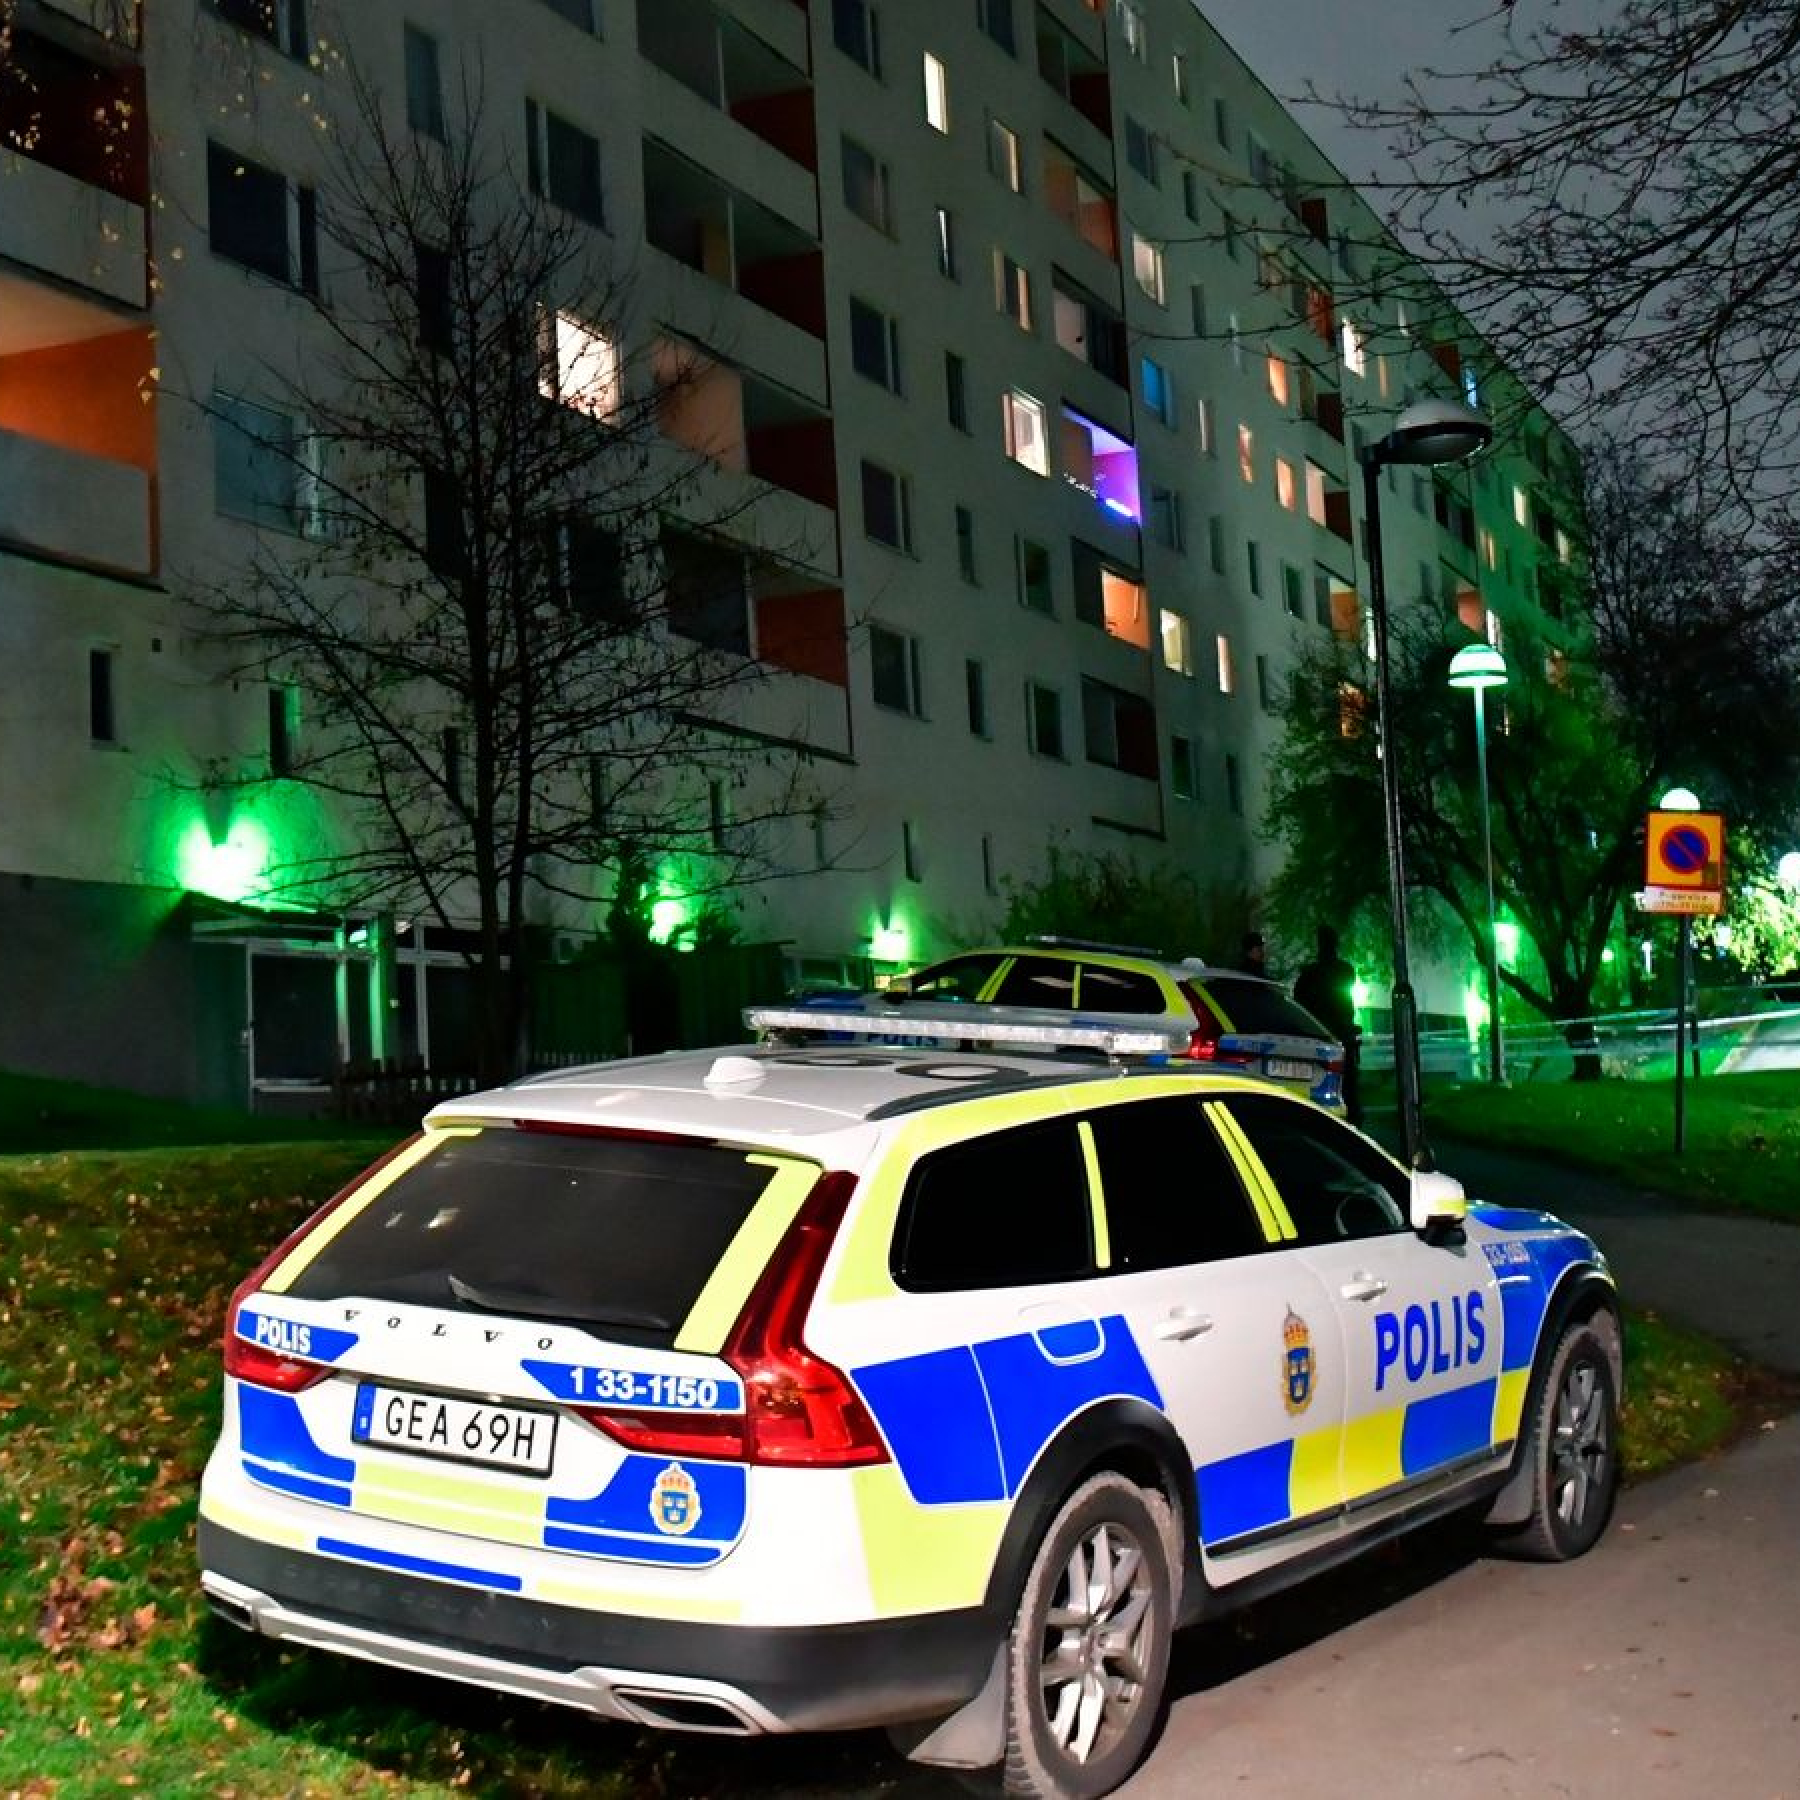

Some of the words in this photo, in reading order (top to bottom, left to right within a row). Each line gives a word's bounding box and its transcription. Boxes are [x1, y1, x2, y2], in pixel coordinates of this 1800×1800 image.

[256, 1314, 311, 1354] POLIS
[343, 1309, 554, 1350] VOLVO
[1373, 1289, 1485, 1392] POLIS
[570, 1366, 585, 1395] 1
[595, 1369, 719, 1408] 33-1150
[385, 1396, 449, 1445] GEA
[462, 1410, 536, 1460] 69H
